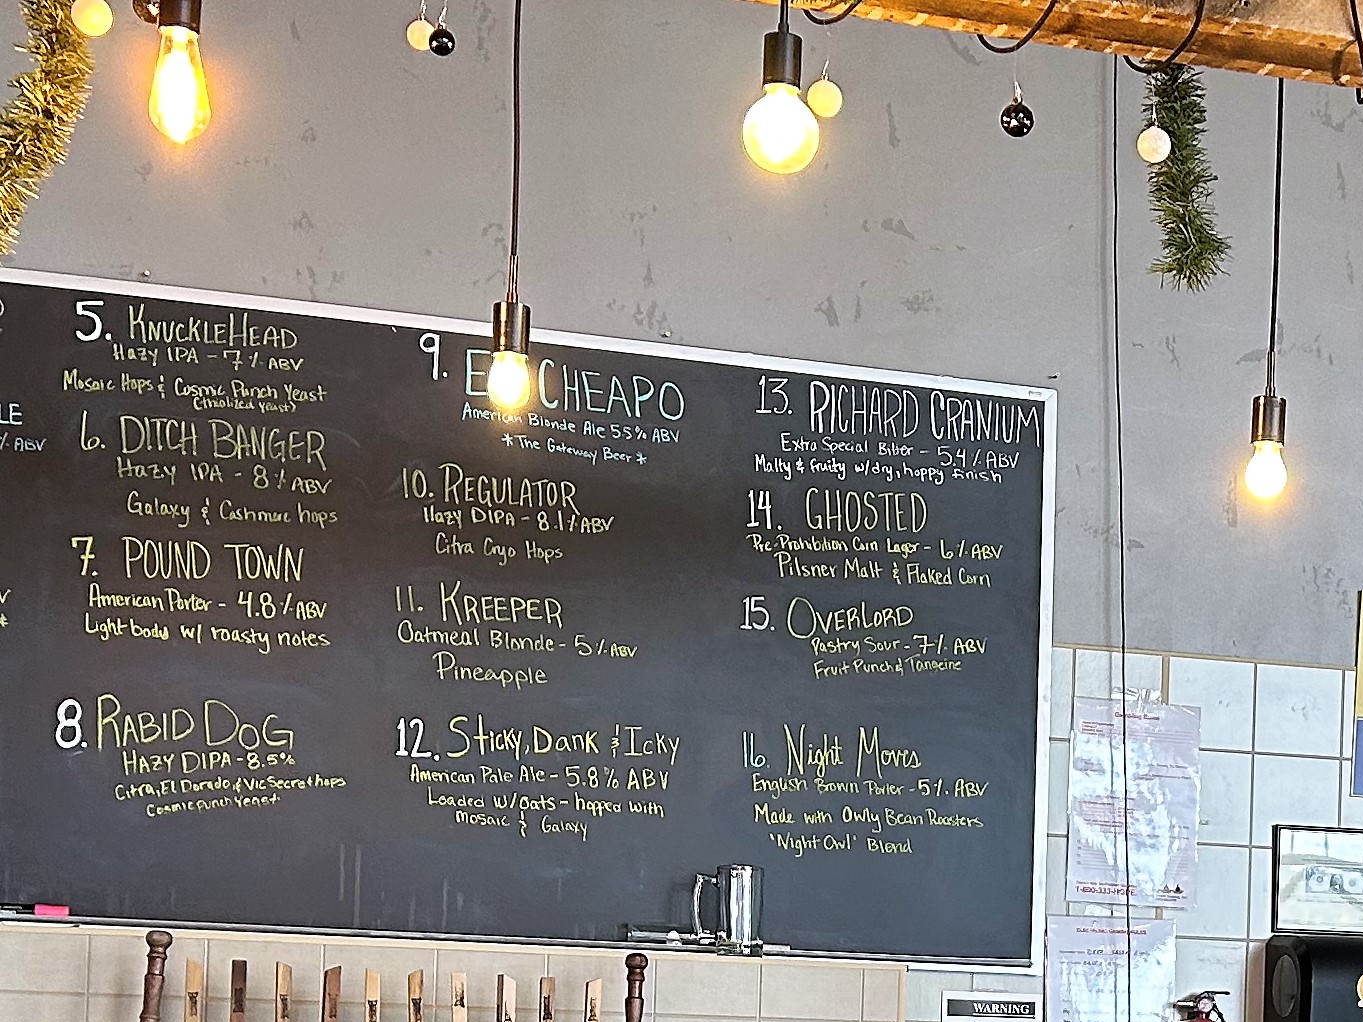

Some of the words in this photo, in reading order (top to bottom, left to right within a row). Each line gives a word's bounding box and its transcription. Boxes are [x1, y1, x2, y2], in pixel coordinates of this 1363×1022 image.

[76, 301, 112, 343] 5.
[113, 343, 158, 366] Hazy
[168, 347, 199, 364] IPA
[269, 358, 304, 371] ABV
[64, 369, 115, 391] Mosaic
[122, 373, 153, 394] Hops
[231, 380, 277, 399] Punch
[420, 333, 447, 380] 9.
[539, 359, 684, 420] CHEAPO
[462, 402, 522, 424] American
[528, 413, 575, 432] Blonde
[583, 421, 605, 438] Ale
[652, 428, 679, 443] ABV
[756, 376, 792, 414] 13.
[810, 380, 919, 437] RICHARD
[930, 391, 1042, 447] CRANIUM
[81, 410, 105, 450] 6.
[120, 416, 197, 456] DITCH
[208, 419, 326, 471] BANGER
[547, 438, 597, 465] Gateway
[603, 447, 632, 462] Beer
[781, 433, 817, 451] Extra
[821, 437, 868, 455] Special
[986, 451, 1019, 469] ABV
[117, 456, 176, 485] Hazy
[191, 463, 223, 483] IPA
[292, 477, 332, 493] ABV
[403, 468, 434, 498] 10.
[755, 454, 791, 480] Malty
[810, 458, 845, 480] fruity
[903, 462, 944, 485] hoppy
[952, 469, 1001, 483] finish
[127, 491, 189, 528] Galaxy
[220, 500, 291, 522] Cashmere
[424, 505, 462, 529] Hazy
[471, 507, 515, 526] DIPA
[581, 517, 614, 533] ABV
[747, 490, 782, 530] 14.
[806, 488, 926, 532] GHOSTED
[72, 537, 98, 576] 7.
[122, 537, 210, 579] POUND
[224, 544, 303, 582] TOWN
[436, 532, 474, 555] Citra
[526, 541, 563, 564] Hops
[853, 536, 878, 551] Corn
[887, 538, 920, 559] Lager
[972, 544, 1003, 560] ABV
[774, 551, 837, 577] Pilsner
[845, 557, 883, 578] Malt
[907, 563, 952, 585] Flaked
[959, 568, 990, 587] Corn
[89, 583, 164, 611] American
[164, 588, 212, 611] Porter
[296, 601, 327, 620] ABV
[396, 586, 423, 612] 11.
[740, 597, 774, 630] 15.
[86, 613, 128, 640] Light
[211, 627, 270, 654] roasty
[278, 630, 330, 646] notes
[398, 620, 479, 646] Oatmeal
[490, 630, 554, 651] Blonde
[611, 643, 637, 657] ABV
[811, 637, 860, 656] Pastry
[864, 637, 900, 652] Sour
[954, 637, 987, 655] ABV
[432, 651, 547, 690] Pineapple
[814, 660, 850, 679] Fruit
[853, 659, 894, 673] Punch
[56, 699, 87, 748] 8.
[396, 718, 439, 761] 12.
[181, 752, 231, 773] DIPA
[743, 732, 769, 768] 16.
[784, 724, 843, 777] Night
[857, 727, 921, 779] Moves
[410, 764, 475, 784] American
[479, 766, 513, 783] Pale
[520, 765, 545, 782] Ale
[627, 768, 668, 789] ABV
[753, 773, 808, 799] English
[863, 780, 904, 795] Porter
[955, 779, 989, 797] ABV
[428, 786, 484, 807] Loaded
[629, 801, 664, 817] with
[755, 803, 795, 824] Made
[804, 811, 832, 824] with
[885, 808, 923, 826] Bean
[542, 815, 587, 841] Galaxy
[867, 838, 912, 853] Blend
[973, 1002, 1029, 1014] WARNING
